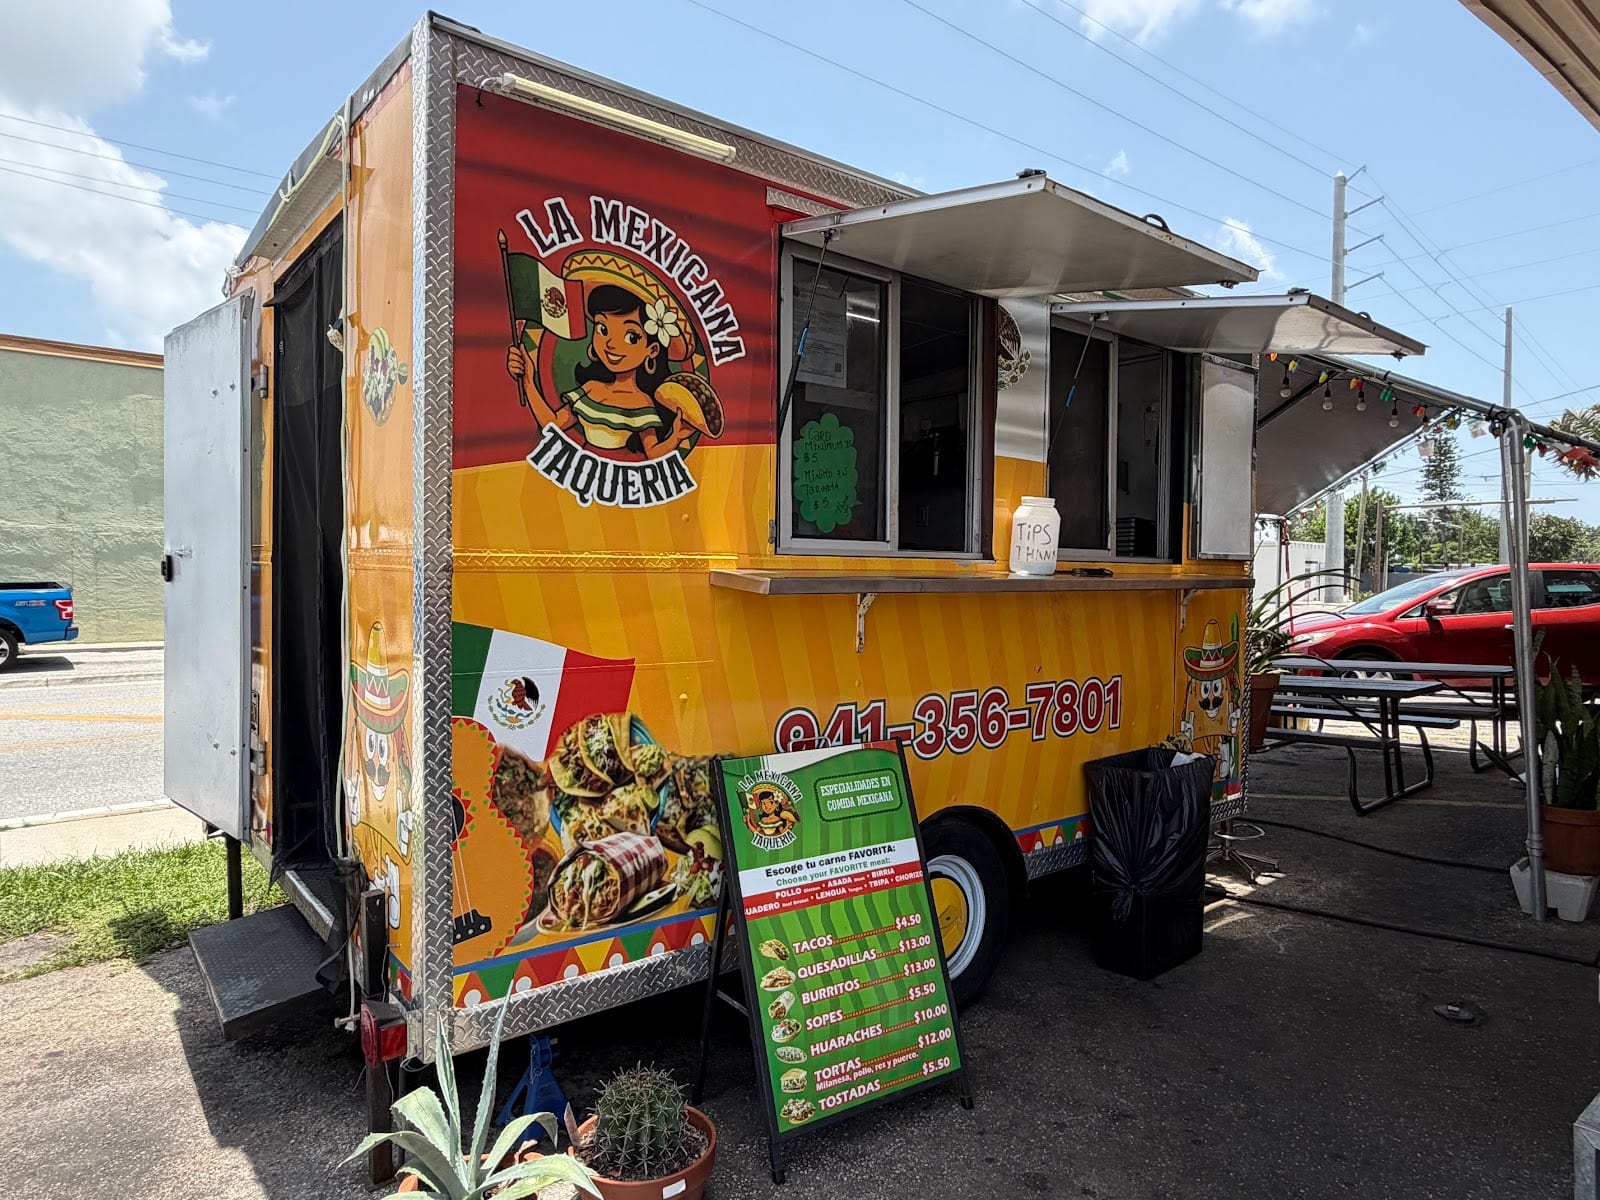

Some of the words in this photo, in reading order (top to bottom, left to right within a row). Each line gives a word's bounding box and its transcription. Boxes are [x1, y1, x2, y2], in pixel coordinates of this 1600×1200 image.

[516, 197, 583, 258] LA
[589, 196, 746, 367] MEXICANA
[526, 422, 697, 508] TAQUERIA
[775, 674, 1122, 760] 941-356-7801
[738, 774, 756, 792] LA
[754, 770, 803, 803] MEXICANA
[820, 778, 880, 796] ESPECIALIDADES
[880, 776, 891, 787] EN
[827, 796, 856, 812] COMIDA
[856, 791, 894, 806] MEXICANA
[751, 829, 797, 851] TAQUERIA
[765, 863, 803, 877] Escoge
[806, 860, 816, 869] tu
[818, 855, 846, 867] carne
[848, 845, 896, 861] FAVORITA:
[776, 874, 807, 887] Choose
[809, 870, 828, 881] your
[829, 861, 868, 875] FAVORITE
[870, 857, 891, 867] meat:
[744, 901, 780, 915] UADERO
[815, 888, 847, 900] LENGUA
[868, 878, 890, 888] TRIPA
[775, 887, 802, 900] POLLO
[827, 876, 853, 888] ASADA
[871, 867, 896, 879] BIRRIA
[793, 934, 833, 954] TACOS
[895, 913, 921, 930] $4.50
[797, 949, 877, 979] QUESADILLAS
[899, 935, 931, 953] $13.00
[801, 978, 860, 1005] BURRITOS
[903, 958, 936, 976] $13.00
[806, 1009, 843, 1031] SOPES
[908, 983, 936, 1001] $5.50
[810, 1023, 883, 1057] HUARACHES
[914, 1004, 948, 1024] $10.00
[814, 1057, 862, 1082] TORTAS
[917, 1027, 952, 1048] $12.00
[815, 1075, 852, 1092] Milanesa,
[853, 1066, 874, 1081] pollo,
[875, 1062, 886, 1071] res
[886, 1060, 892, 1069] y
[892, 1051, 919, 1067] puerco.
[818, 1079, 881, 1111] TOSTADAS
[922, 1056, 950, 1076] $5.50
